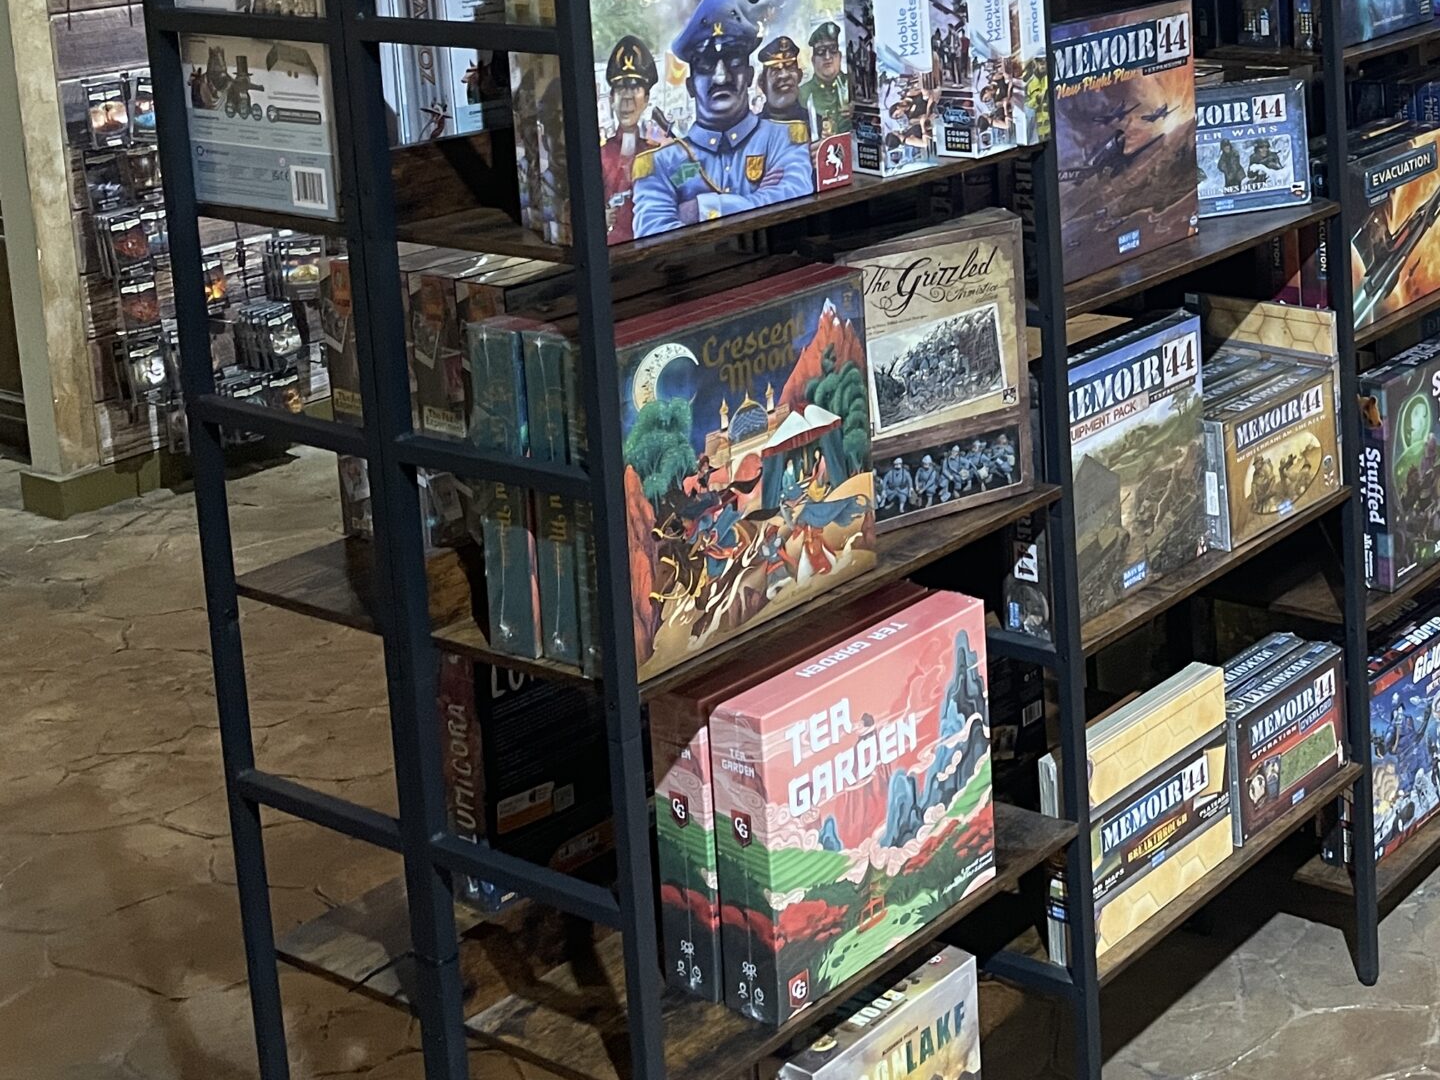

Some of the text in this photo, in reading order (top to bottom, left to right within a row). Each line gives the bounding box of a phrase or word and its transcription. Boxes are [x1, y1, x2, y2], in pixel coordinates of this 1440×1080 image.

[899, 7, 908, 57] Mobile
[1053, 28, 1156, 82] MEMOIR
[1056, 68, 1138, 100] New Flight Plan
[1231, 124, 1278, 138] WARS
[1372, 152, 1431, 187] EVACUATION
[864, 246, 998, 317] The Grizzled
[1071, 401, 1138, 442] UIPMENT PACK
[1236, 399, 1299, 449] MEMOIR
[1365, 447, 1386, 526] Stuffed
[1251, 687, 1313, 747] MEMOIR
[787, 713, 918, 818] GARDEN
[1252, 724, 1297, 761] OPERATION
[721, 758, 756, 778] GARDEN
[1102, 778, 1183, 853] MEMOIR
[1127, 812, 1189, 864] BREAKTHROUGH
[1105, 867, 1125, 888] MAPS
[906, 999, 966, 1076] LAKE
